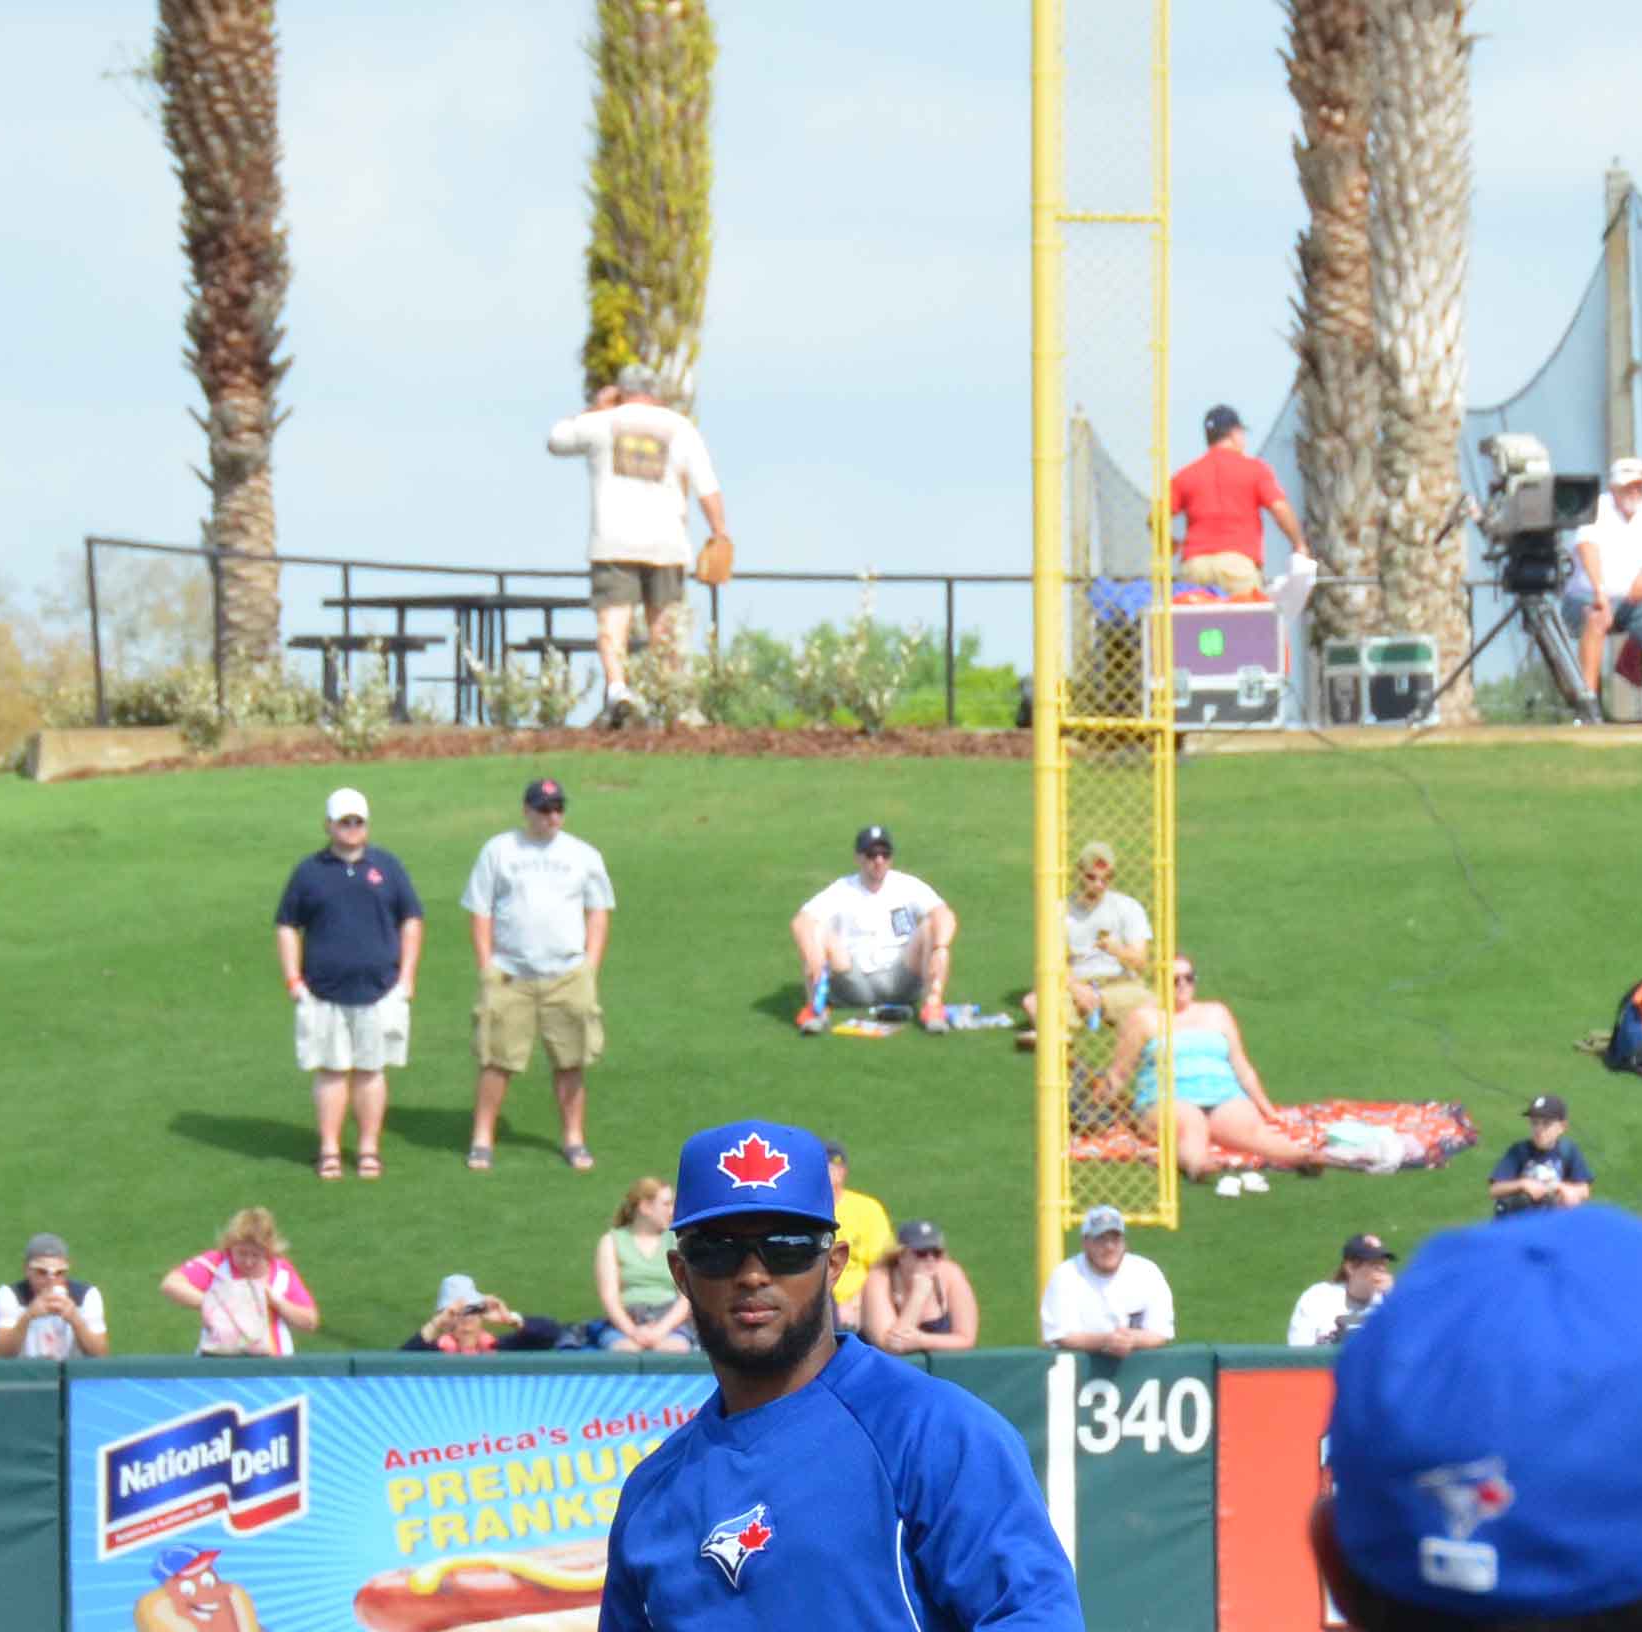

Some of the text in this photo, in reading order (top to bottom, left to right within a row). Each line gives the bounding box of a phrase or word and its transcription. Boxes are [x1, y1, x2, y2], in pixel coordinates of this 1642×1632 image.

[383, 1424, 570, 1471] America's
[1076, 1376, 1214, 1454] 340
[119, 1425, 232, 1499] National
[230, 1432, 290, 1486] Deli
[394, 1486, 621, 1555] FRANKS
